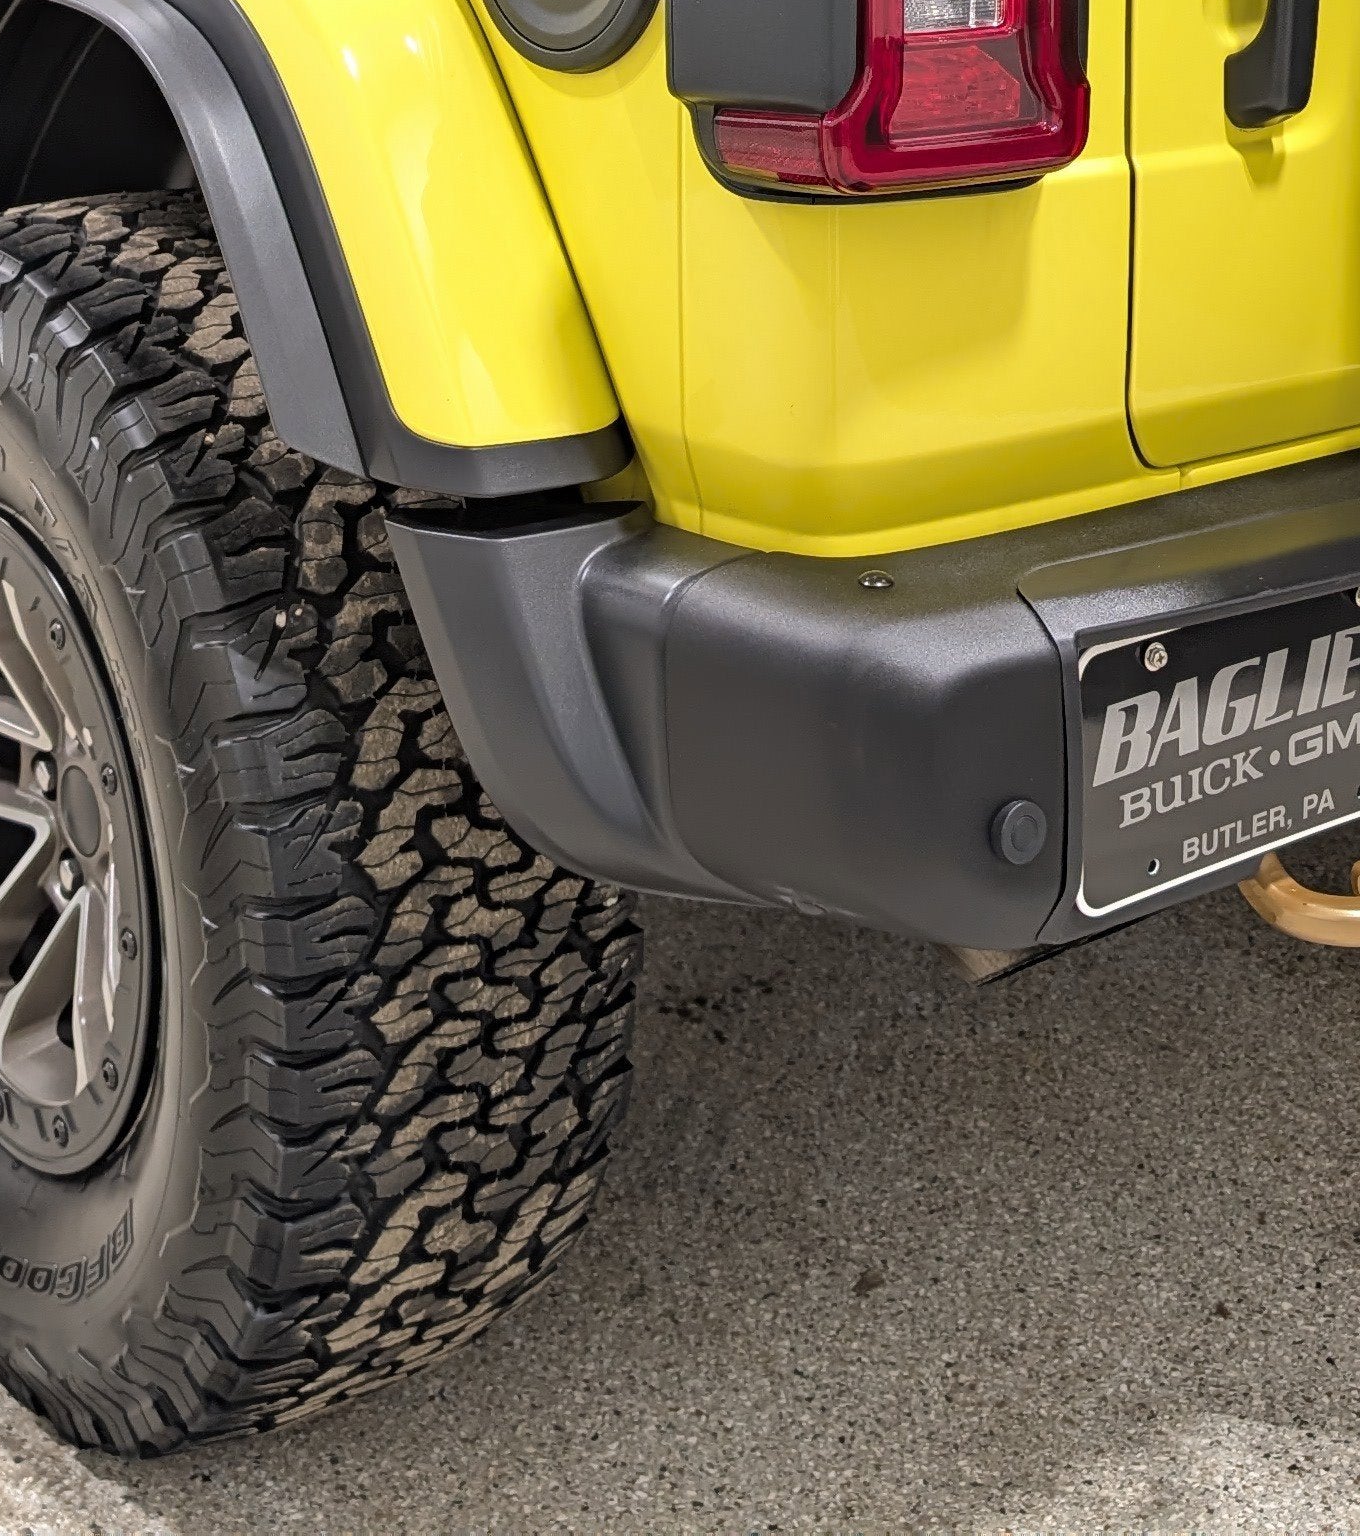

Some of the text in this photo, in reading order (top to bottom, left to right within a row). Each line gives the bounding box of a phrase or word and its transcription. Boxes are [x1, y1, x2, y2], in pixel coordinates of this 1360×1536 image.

[1119, 745, 1265, 829] BUICK
[1182, 789, 1336, 864] BUTLER, PA
